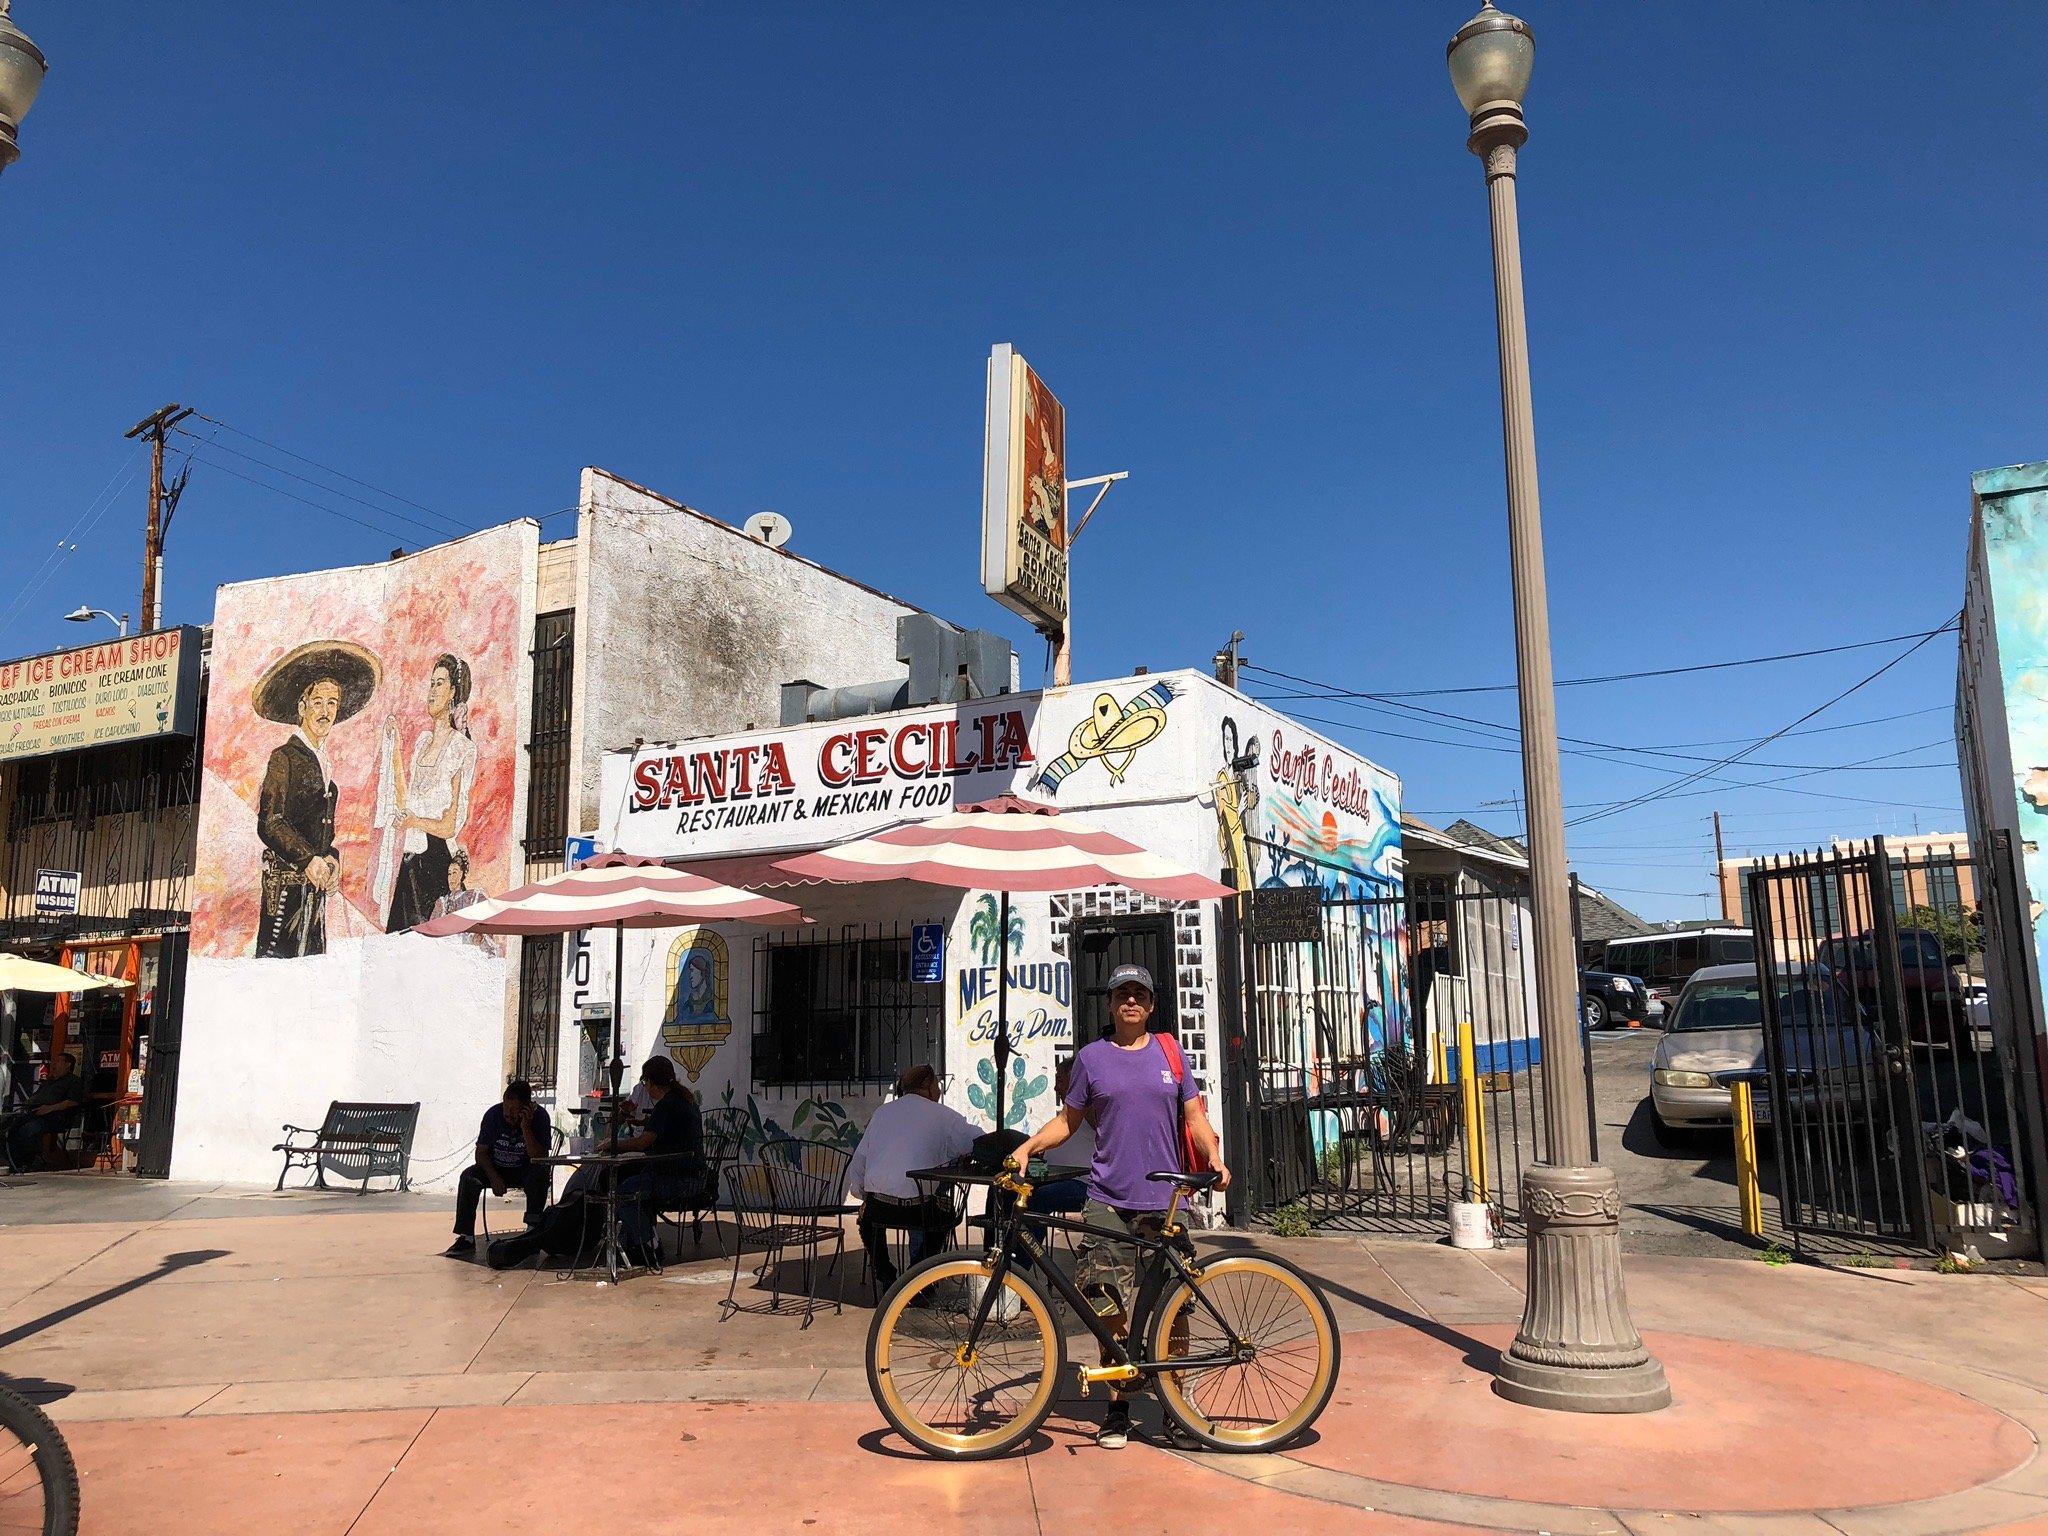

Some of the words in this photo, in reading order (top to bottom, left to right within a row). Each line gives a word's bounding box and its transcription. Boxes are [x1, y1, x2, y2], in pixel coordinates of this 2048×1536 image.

[1018, 567, 1067, 620] MEXICANA
[1023, 552, 1063, 597] COMIDA
[26, 658, 54, 684] ICE
[60, 643, 123, 678] CREAM
[130, 631, 180, 665] SHOP
[49, 679, 87, 698] BIONICOS
[98, 674, 113, 688] ICE
[113, 667, 143, 685] CREAM
[145, 664, 168, 680] CONE
[49, 731, 85, 746] SMOOTHIES
[94, 727, 104, 739] ICE
[628, 741, 796, 814] SANTA
[818, 710, 1037, 789] CECILIA
[1270, 729, 1319, 807] Santa
[1321, 754, 1371, 827] Cecilia
[676, 799, 794, 835] RESTAURANT
[793, 800, 808, 821] &
[811, 788, 893, 818] MEXICAN
[899, 782, 952, 810] FOOD
[36, 894, 75, 908] INSIDE
[38, 875, 77, 894] ATM
[959, 962, 1071, 1020] MENUDO
[1009, 1020, 1025, 1048] y
[1027, 1008, 1072, 1039] Dom.
